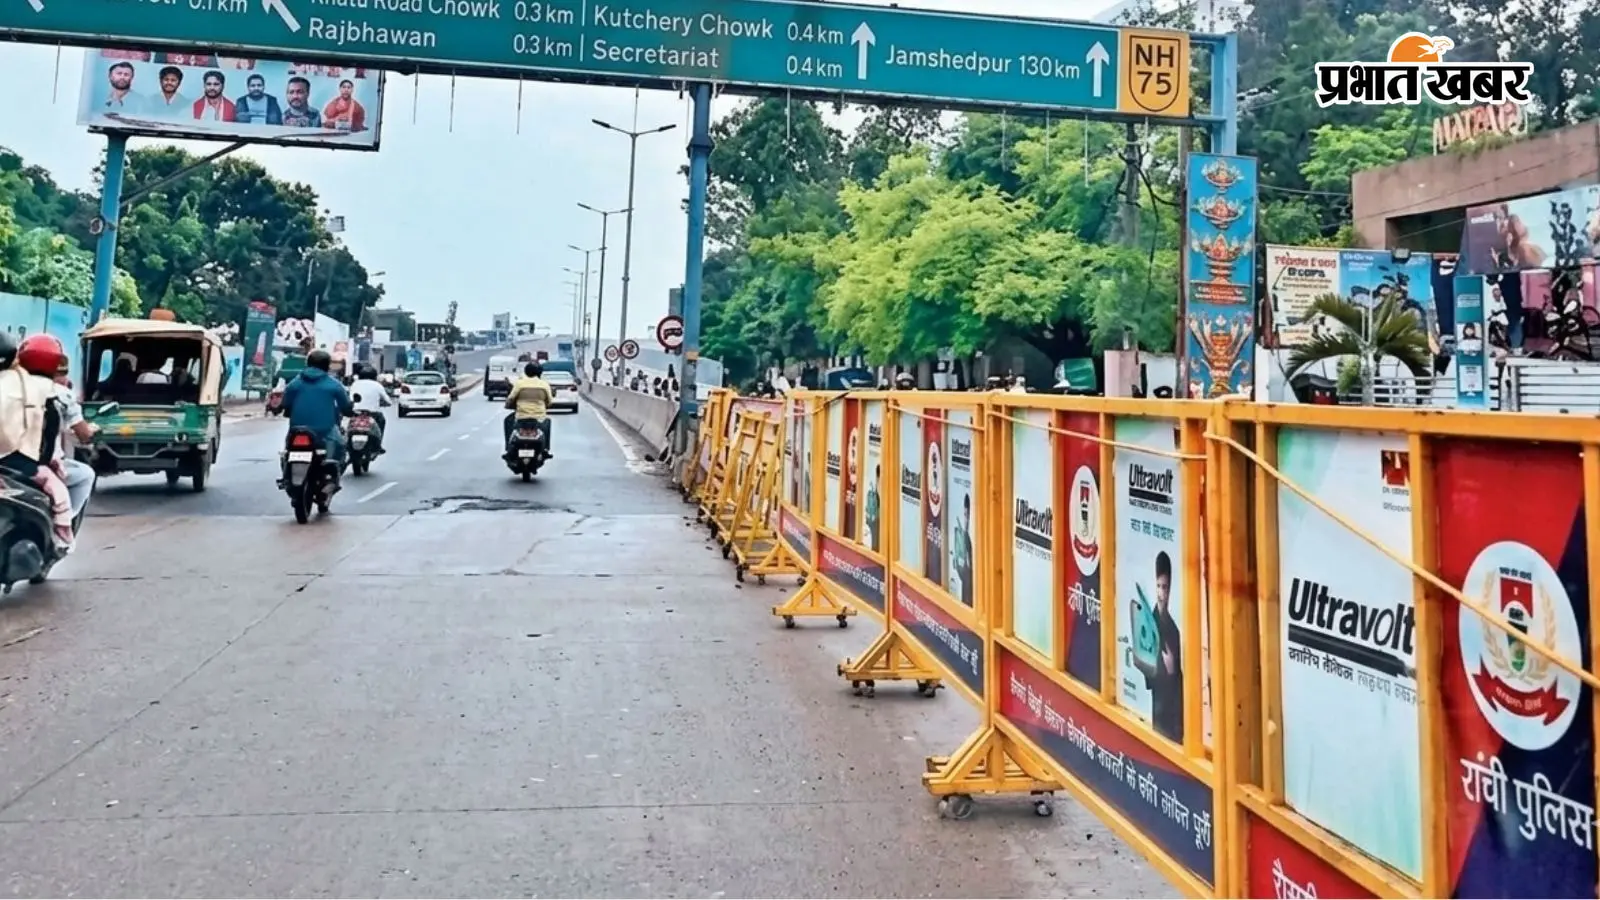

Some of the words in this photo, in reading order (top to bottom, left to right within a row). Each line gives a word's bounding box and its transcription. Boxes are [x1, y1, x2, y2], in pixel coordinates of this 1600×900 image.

[217, 0, 247, 13] km
[428, 0, 500, 19] Chowk
[514, 1, 541, 21] 0.3
[546, 4, 574, 24] km
[308, 17, 436, 47] Rajbhawan
[513, 34, 540, 54] 0.3
[545, 38, 573, 57] km
[593, 6, 693, 37] Kutchery
[699, 13, 774, 39] Chowk
[787, 22, 813, 42] 0.4
[817, 25, 844, 45] km
[592, 39, 719, 68] Secretariat
[786, 55, 813, 76] 0.4
[816, 58, 843, 78] km
[885, 44, 1012, 76] Jamshedpur
[1019, 55, 1052, 76] 130
[1054, 59, 1081, 79] km
[1135, 43, 1174, 68] NH
[1136, 71, 1172, 95] 75
[1127, 463, 1173, 494] Ultravolt
[1288, 577, 1416, 655] Ultravolt
[1460, 751, 1508, 815] रांची
[1513, 772, 1594, 850] पुलिस
